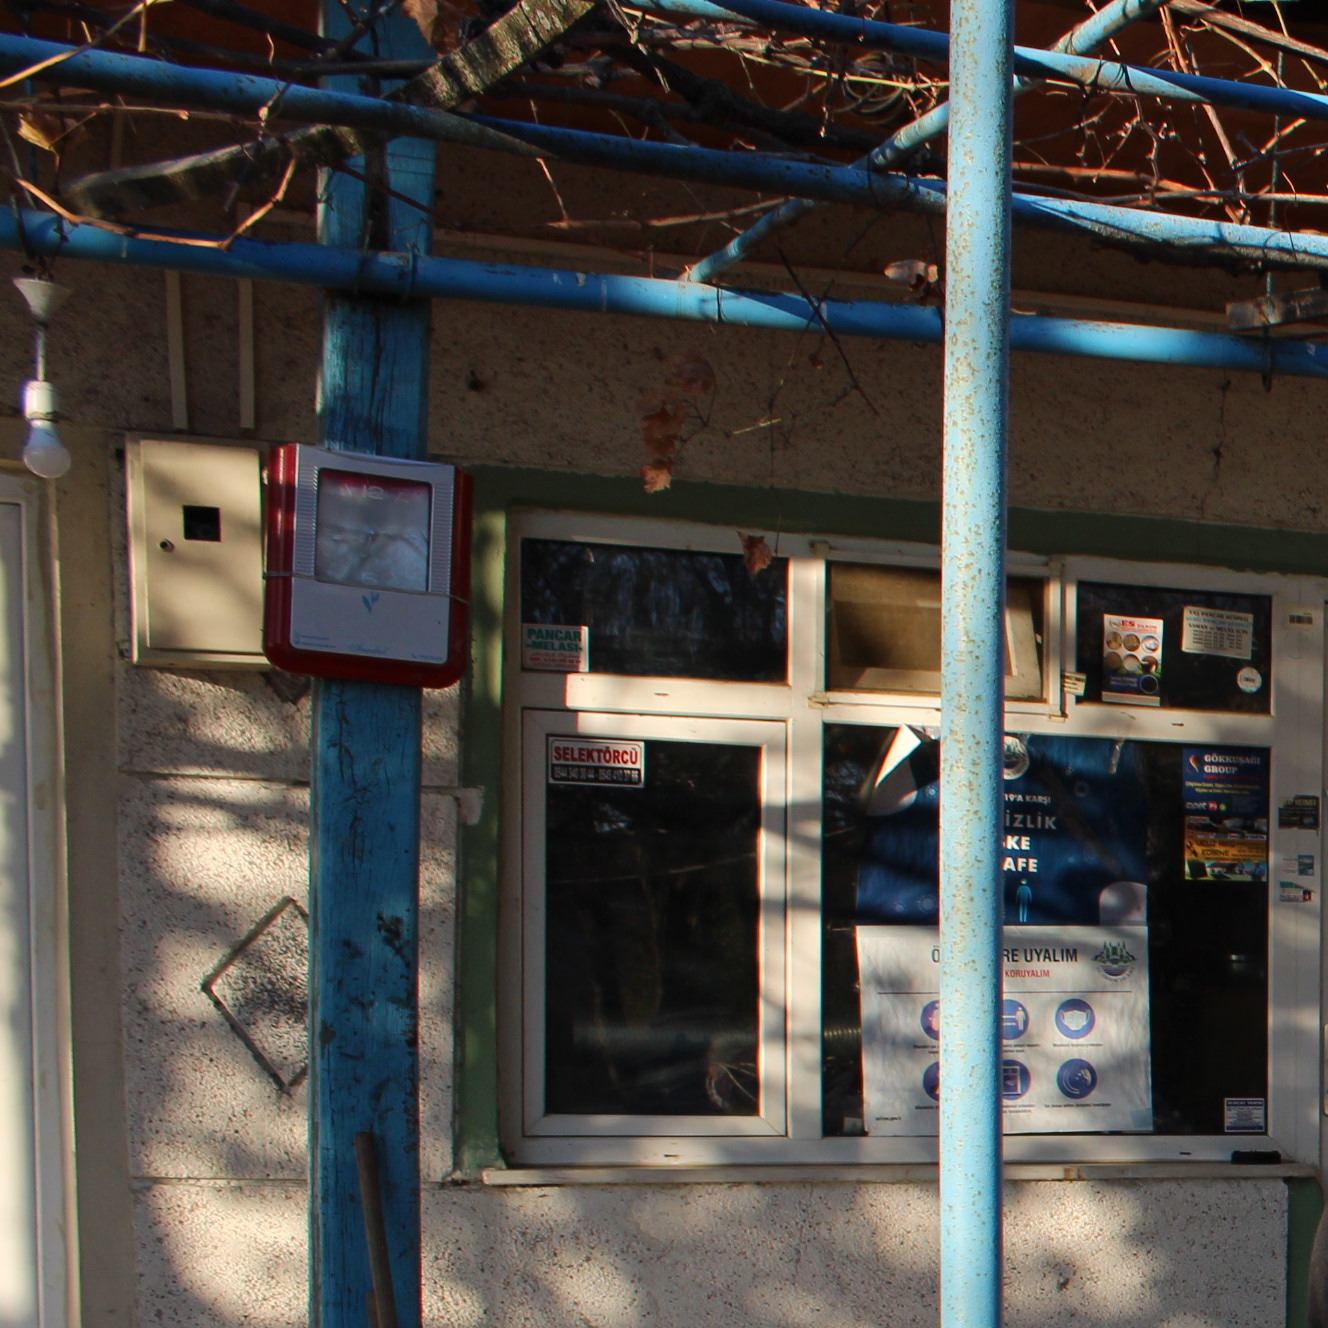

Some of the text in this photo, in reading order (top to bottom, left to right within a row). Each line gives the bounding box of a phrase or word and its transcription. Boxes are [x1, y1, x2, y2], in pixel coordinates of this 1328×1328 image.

[527, 627, 582, 642] PANCAR
[553, 745, 639, 765] SELEKTÖRCÜ
[1204, 752, 1261, 765] GÖKKUŞAĞI
[1204, 765, 1238, 774] GROUP
[1025, 794, 1050, 805] KARŞI
[1005, 810, 1057, 830] İZLİK
[1003, 834, 1031, 851] KE
[1003, 857, 1038, 873] AFE
[1024, 948, 1078, 963] UYALIM
[1005, 969, 1050, 979] KORUYALIM
